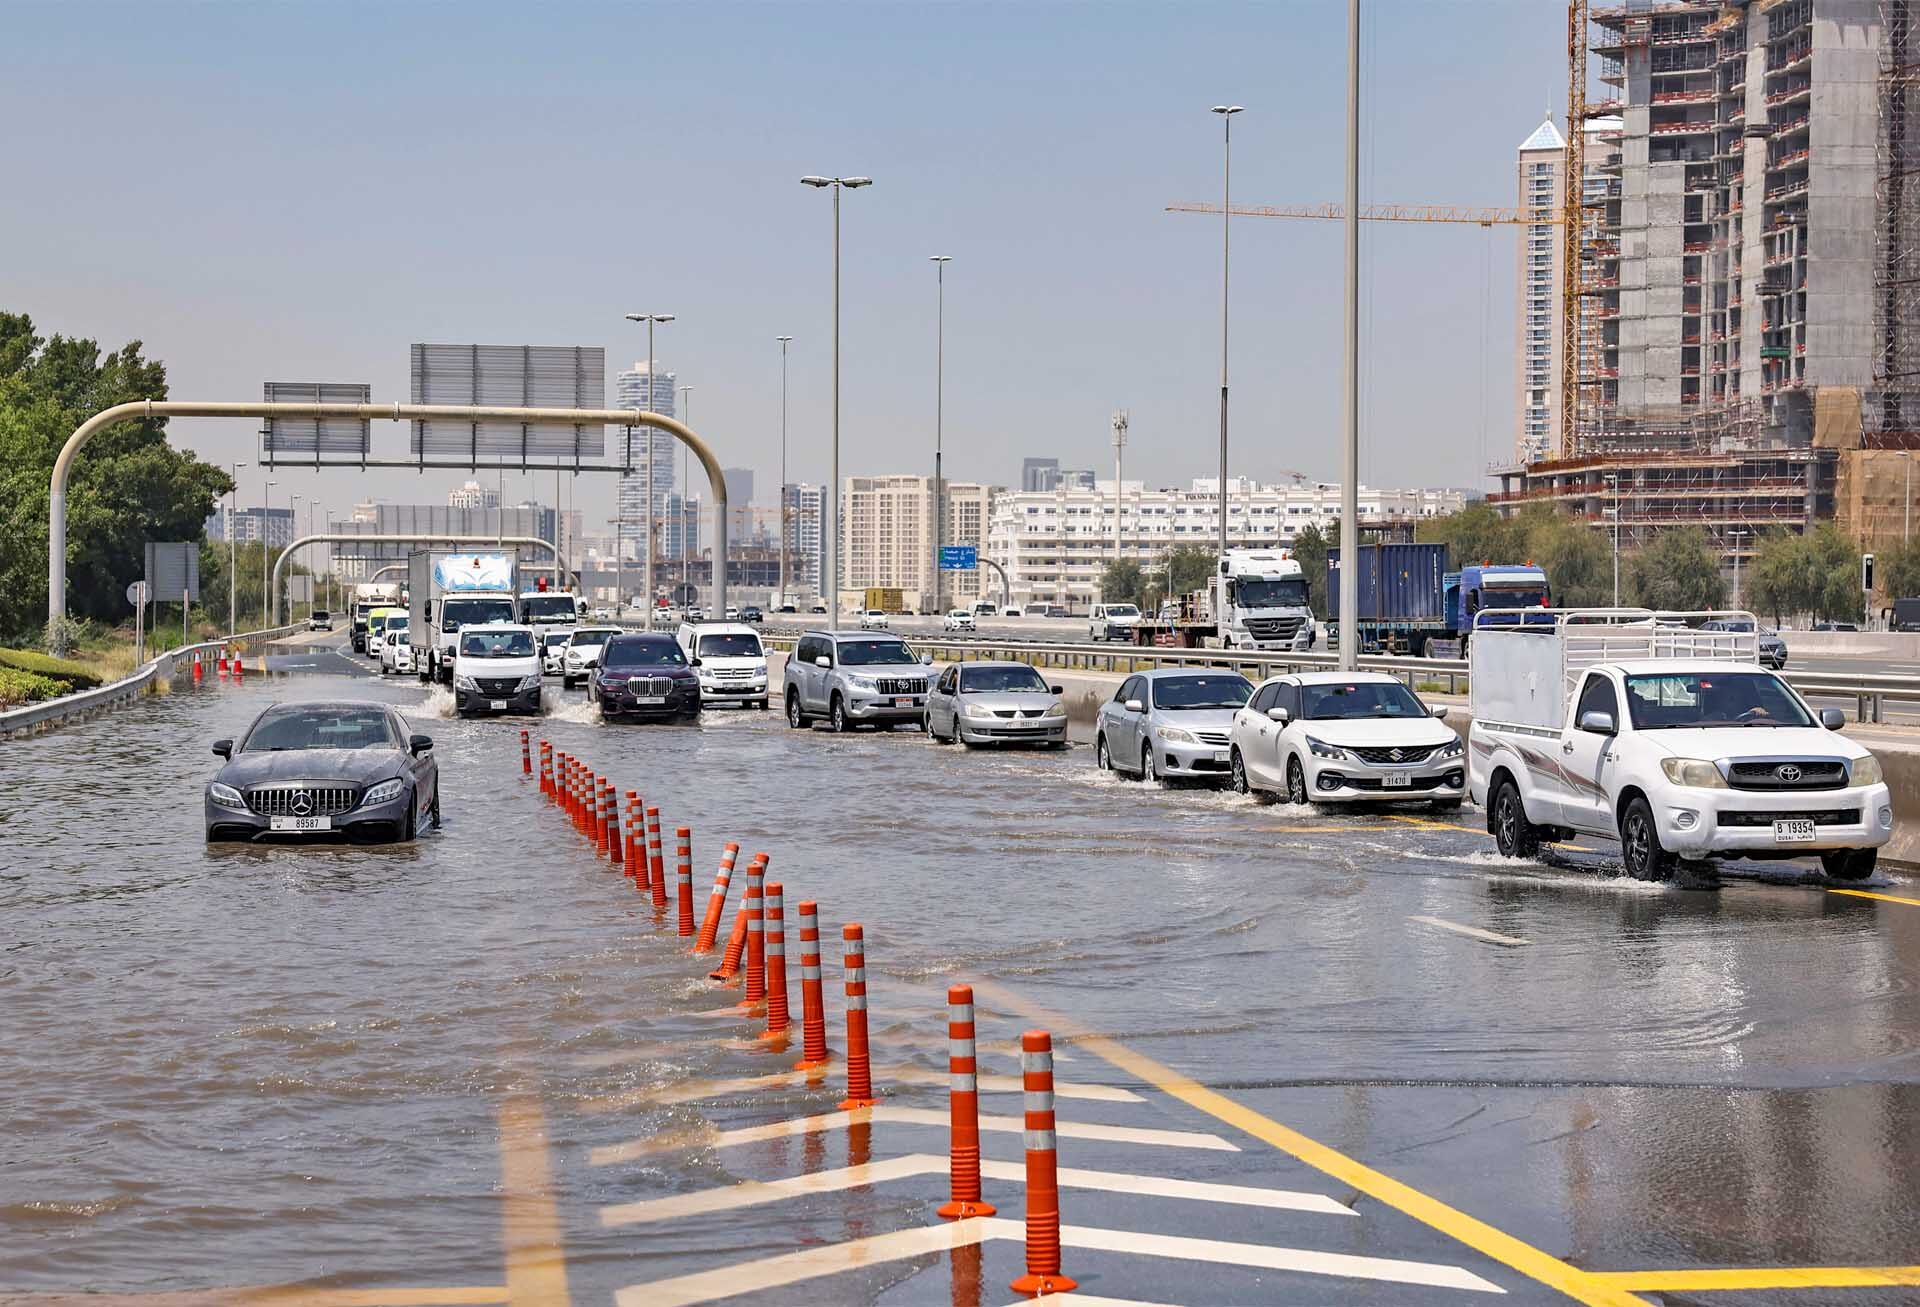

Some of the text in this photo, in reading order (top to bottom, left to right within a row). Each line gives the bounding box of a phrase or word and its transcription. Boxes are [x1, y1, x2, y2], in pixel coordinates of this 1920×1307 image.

[296, 818, 319, 829] 89587
[1777, 822, 1813, 833] B 19354
